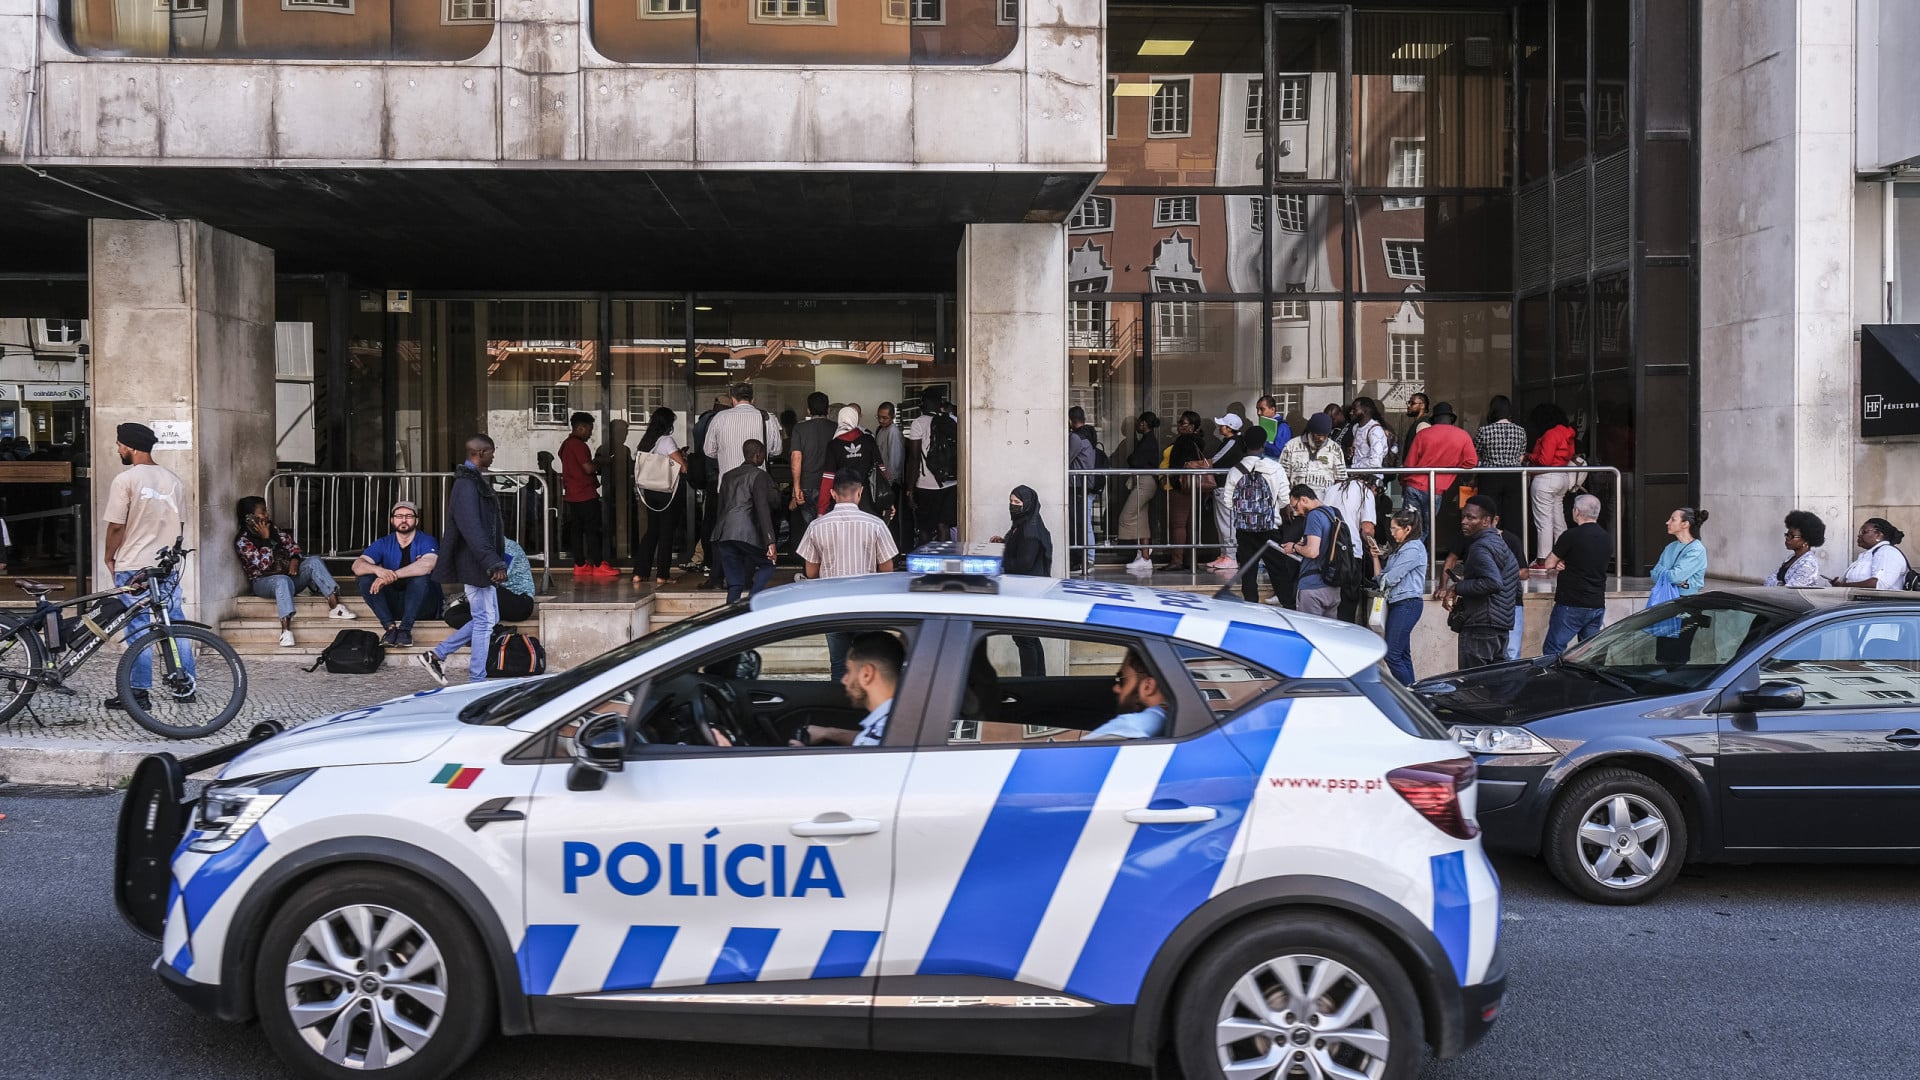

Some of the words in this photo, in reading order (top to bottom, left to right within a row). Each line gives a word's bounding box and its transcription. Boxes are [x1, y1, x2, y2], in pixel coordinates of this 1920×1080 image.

[1866, 401, 1880, 412] HF
[69, 613, 126, 666] ROCKDER
[1270, 775, 1383, 794] www.psp.pt
[562, 827, 845, 899] POLÍCIA
